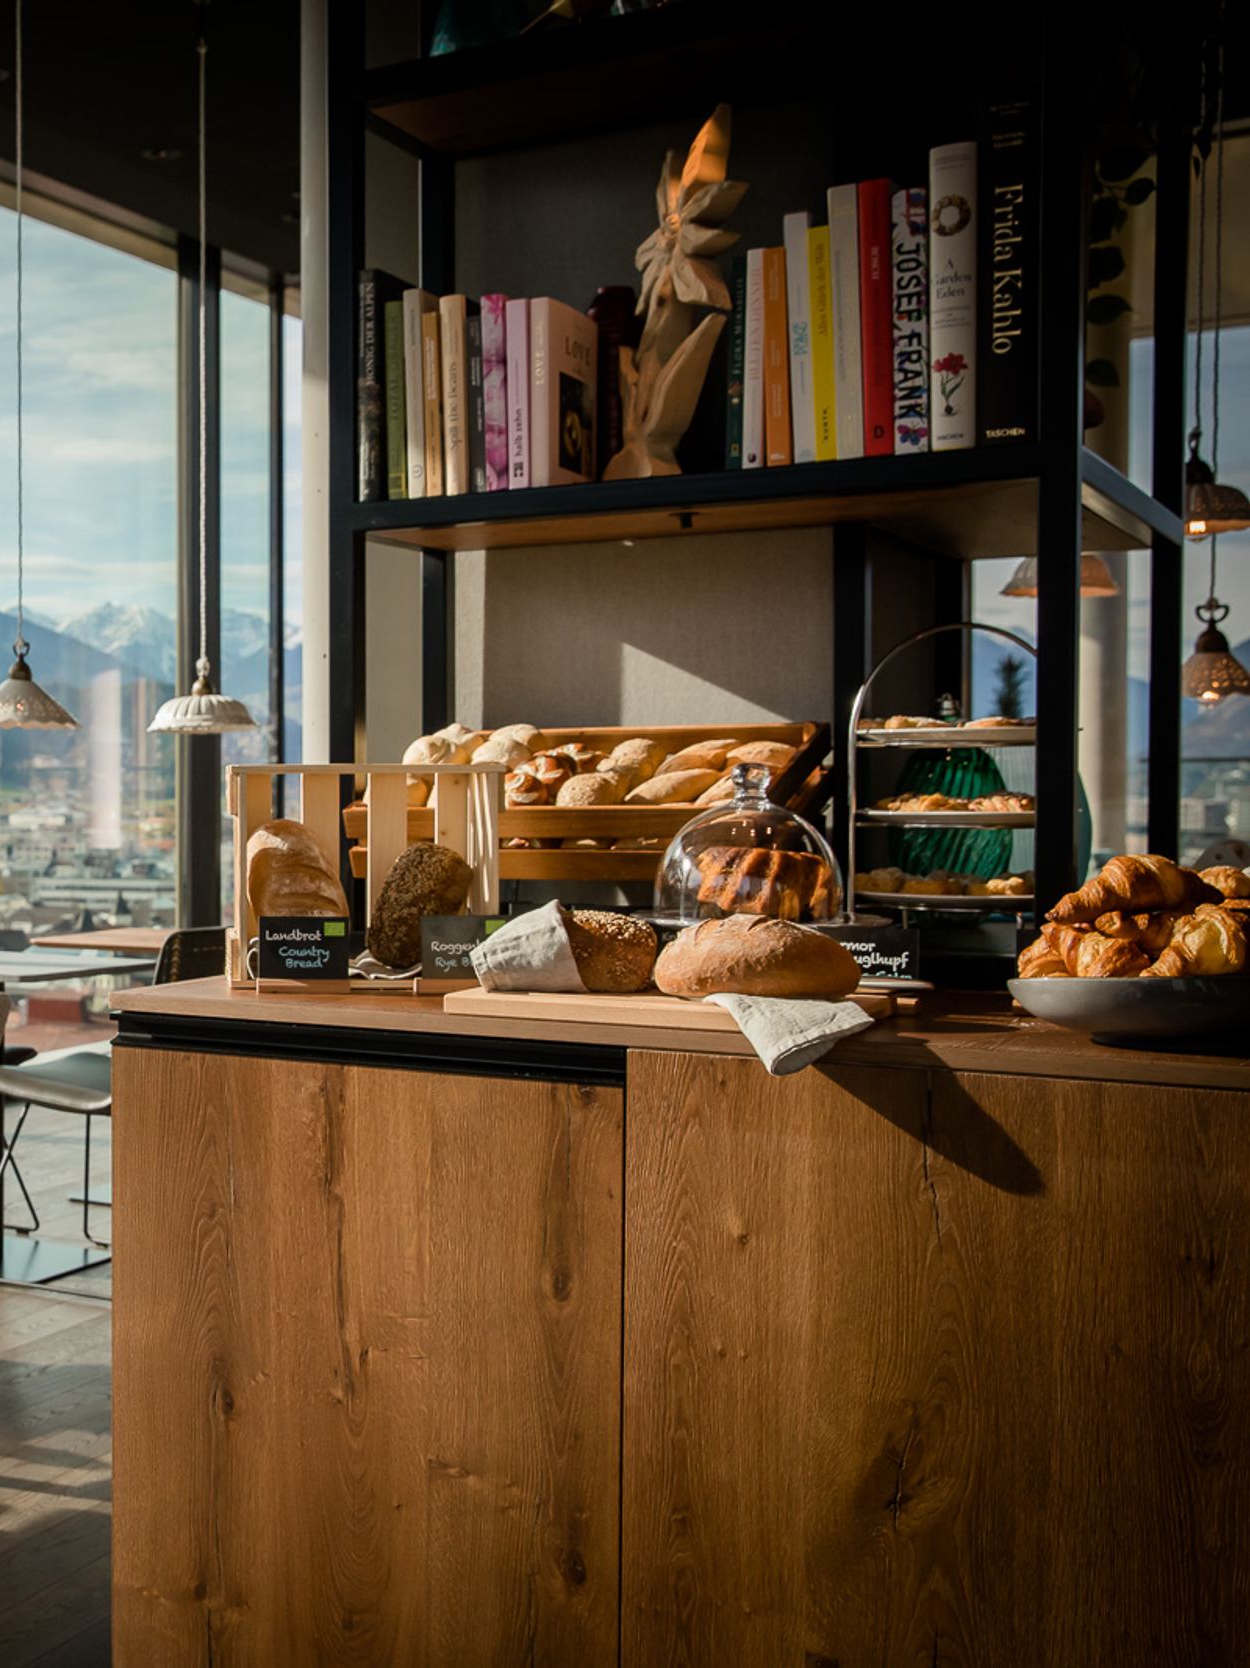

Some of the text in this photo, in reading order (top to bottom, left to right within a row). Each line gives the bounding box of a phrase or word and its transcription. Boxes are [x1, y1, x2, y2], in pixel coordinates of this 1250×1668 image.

[992, 183, 1023, 263] Frida
[991, 267, 1023, 355] Kahlo
[365, 282, 375, 385] HONIG DER ALPEN
[896, 242, 923, 419] JOSEF FRANK
[565, 336, 591, 366] LOVE
[535, 351, 544, 385] LOVE
[448, 404, 459, 422] the
[514, 409, 523, 456] halb zehn
[985, 427, 1025, 438] TASCHEN
[265, 928, 322, 941] Landbrot
[278, 945, 330, 962] Country
[285, 957, 323, 968] Bread
[435, 956, 474, 972] Rye B
